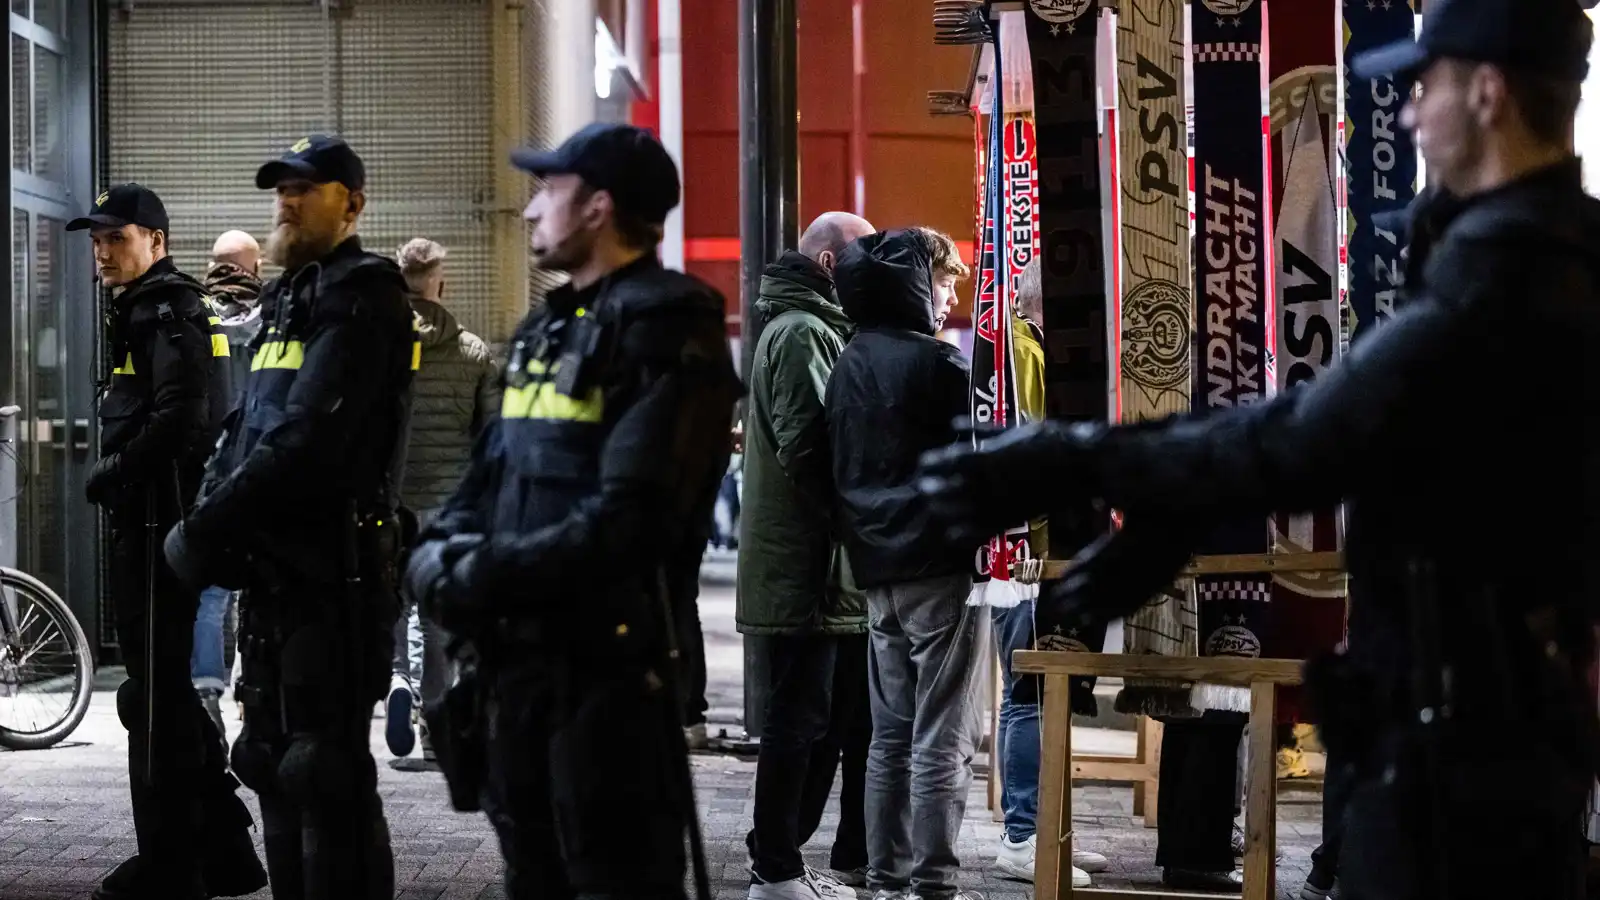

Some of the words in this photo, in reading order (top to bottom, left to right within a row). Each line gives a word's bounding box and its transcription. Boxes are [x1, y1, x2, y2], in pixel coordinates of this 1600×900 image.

[1136, 52, 1180, 198] PSV
[1371, 72, 1399, 200] FORÇ
[1011, 163, 1031, 267] GEKSTE
[1233, 178, 1258, 324] MACHT
[1205, 163, 1233, 408] NDRACHT
[1374, 252, 1397, 333] AZ
[1234, 332, 1259, 410] AKT
